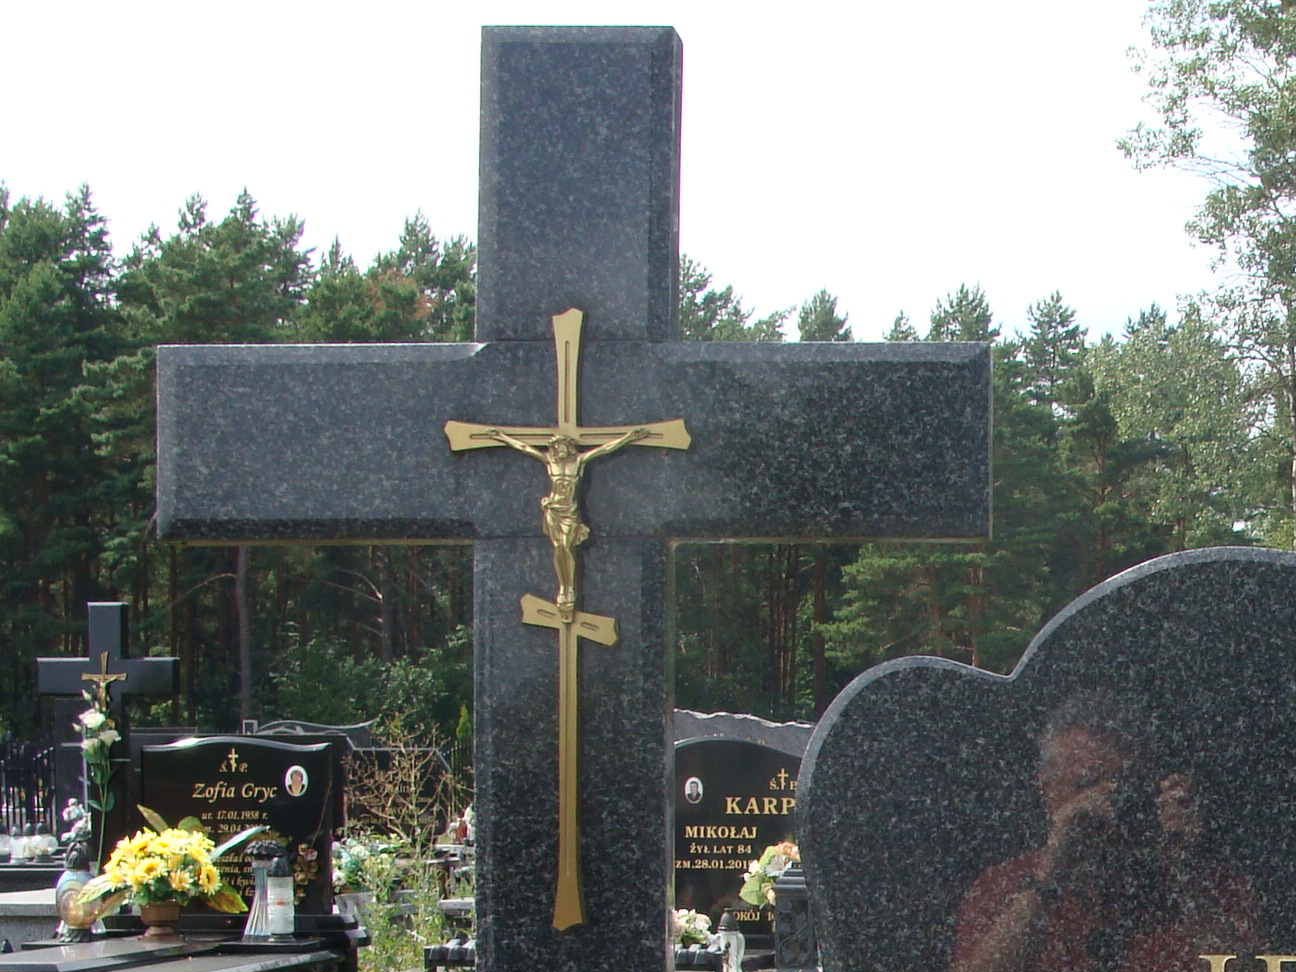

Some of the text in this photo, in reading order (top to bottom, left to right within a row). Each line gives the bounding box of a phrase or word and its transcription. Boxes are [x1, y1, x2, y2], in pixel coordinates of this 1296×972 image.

[769, 777, 780, 791] Ś.
[192, 781, 278, 804] Zofia Gryc
[684, 825, 758, 839] MIKOŁAJ
[689, 842, 752, 854] ŻYŁ LAT 84
[674, 859, 751, 870] ZM.28.01.201
